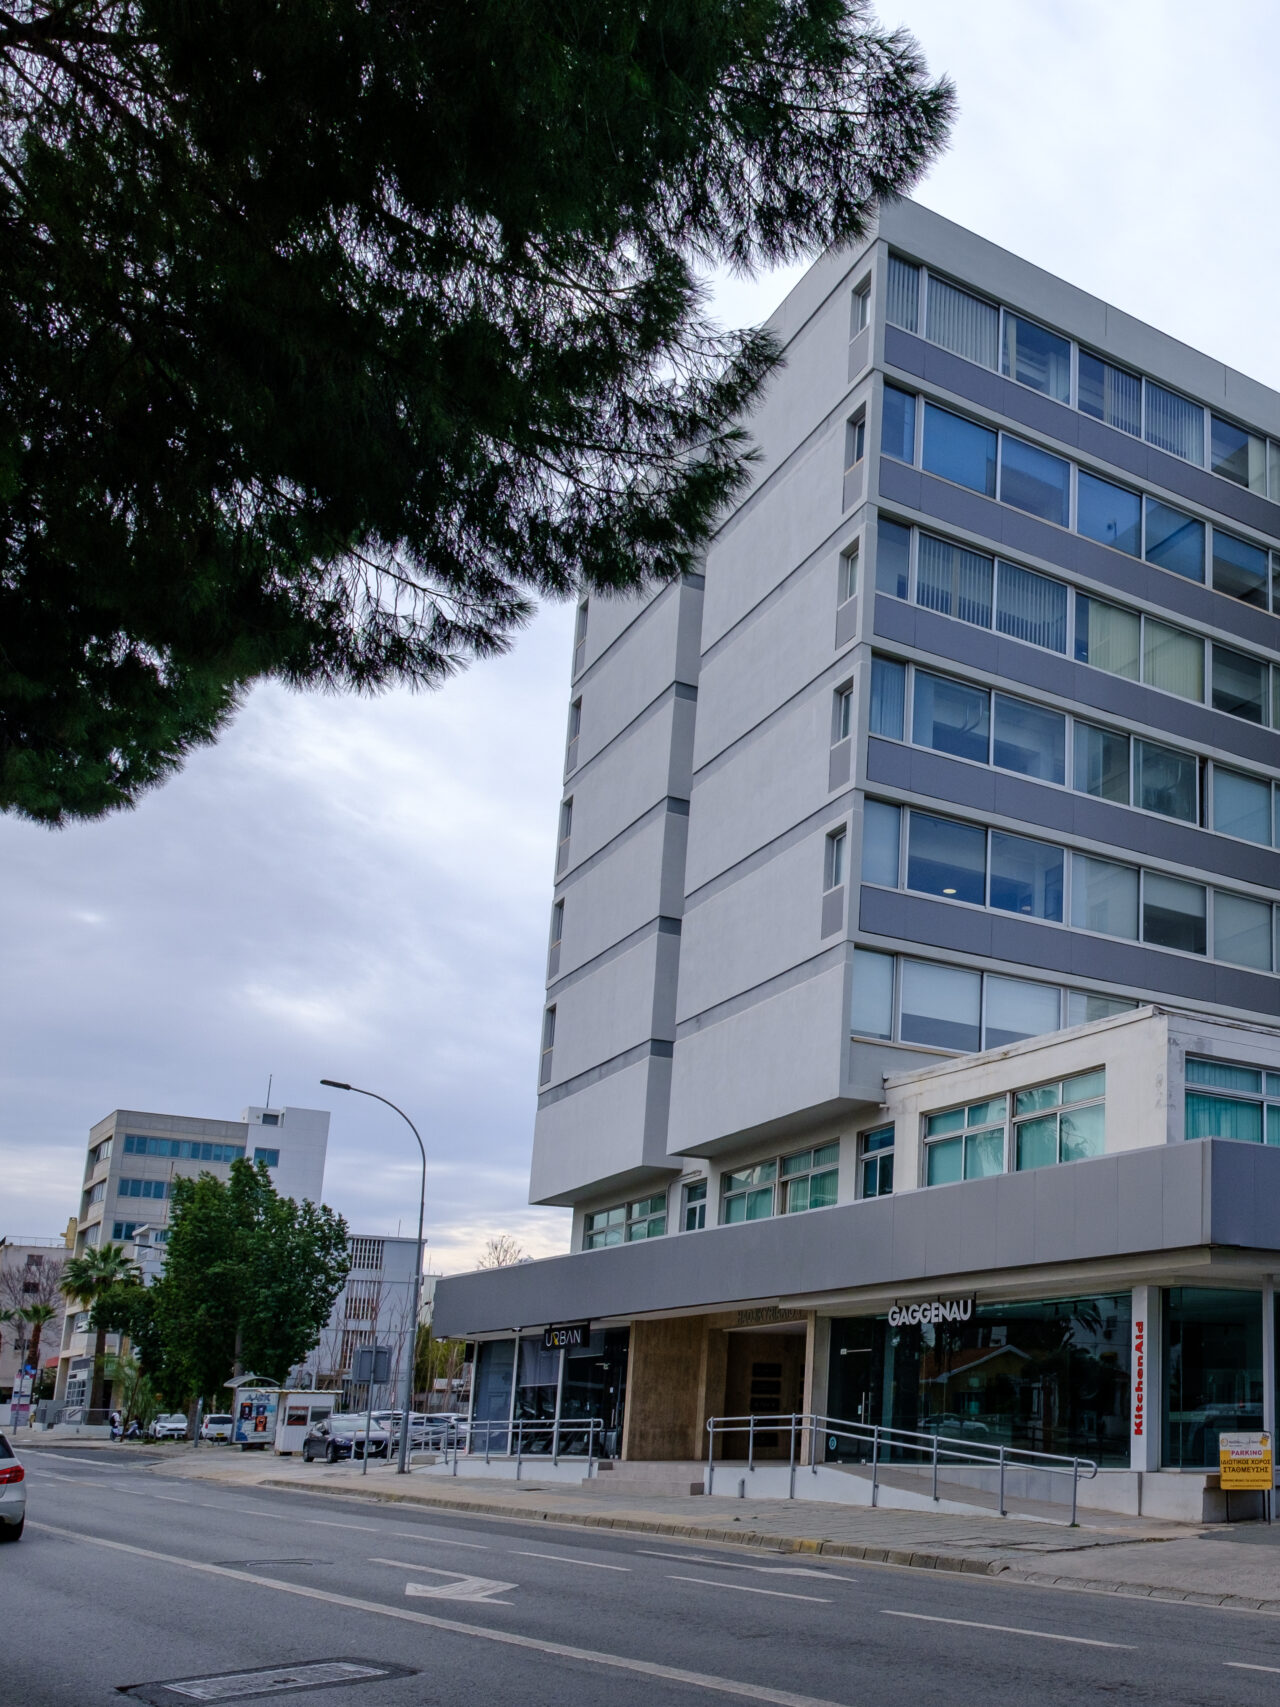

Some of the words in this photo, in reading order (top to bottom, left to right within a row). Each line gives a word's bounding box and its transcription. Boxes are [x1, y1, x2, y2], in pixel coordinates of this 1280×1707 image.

[888, 1299, 972, 1326] GAGGENAU
[545, 1329, 581, 1347] URBAN
[1134, 1321, 1143, 1435] KitchenAid
